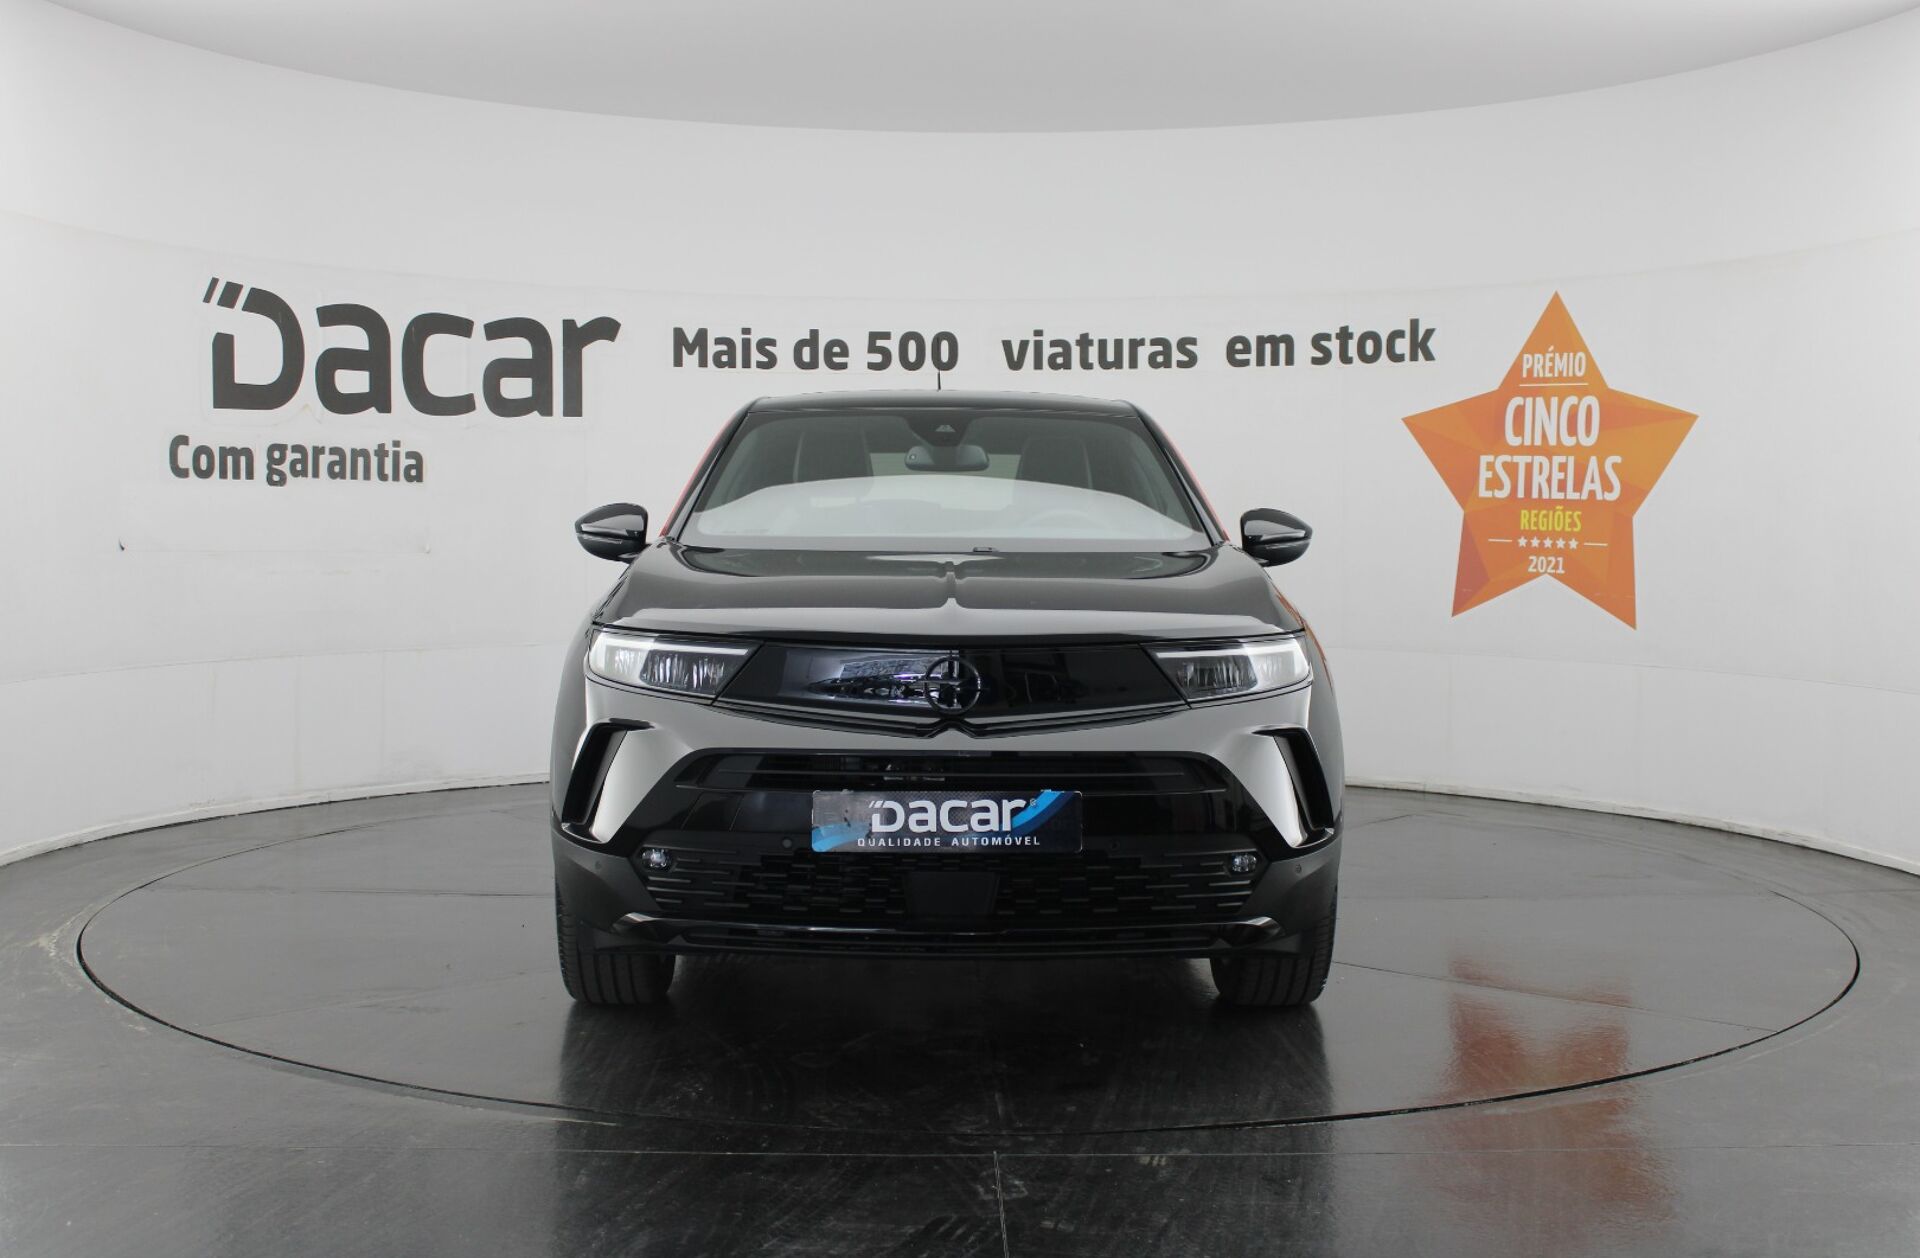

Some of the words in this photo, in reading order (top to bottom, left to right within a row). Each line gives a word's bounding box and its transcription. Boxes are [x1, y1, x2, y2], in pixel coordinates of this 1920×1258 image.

[202, 277, 622, 418] Dacar
[673, 327, 778, 370] Mais
[793, 328, 850, 371] de
[866, 331, 960, 371] 500
[1001, 329, 1198, 372] viaturas
[1225, 333, 1295, 368] em
[1310, 318, 1437, 366] stock
[1522, 346, 1587, 378] PRÉMIO
[1504, 395, 1600, 447] CINCO
[169, 434, 255, 481] Com
[266, 440, 425, 487] garantia
[1478, 454, 1622, 501] ESTRELAS
[1519, 505, 1582, 532] REGIÕES
[1527, 555, 1566, 575] 2021
[868, 798, 1027, 833] Dacar
[857, 837, 941, 848] QUALIDADE
[951, 834, 1041, 847] AUTOMÓVEL
